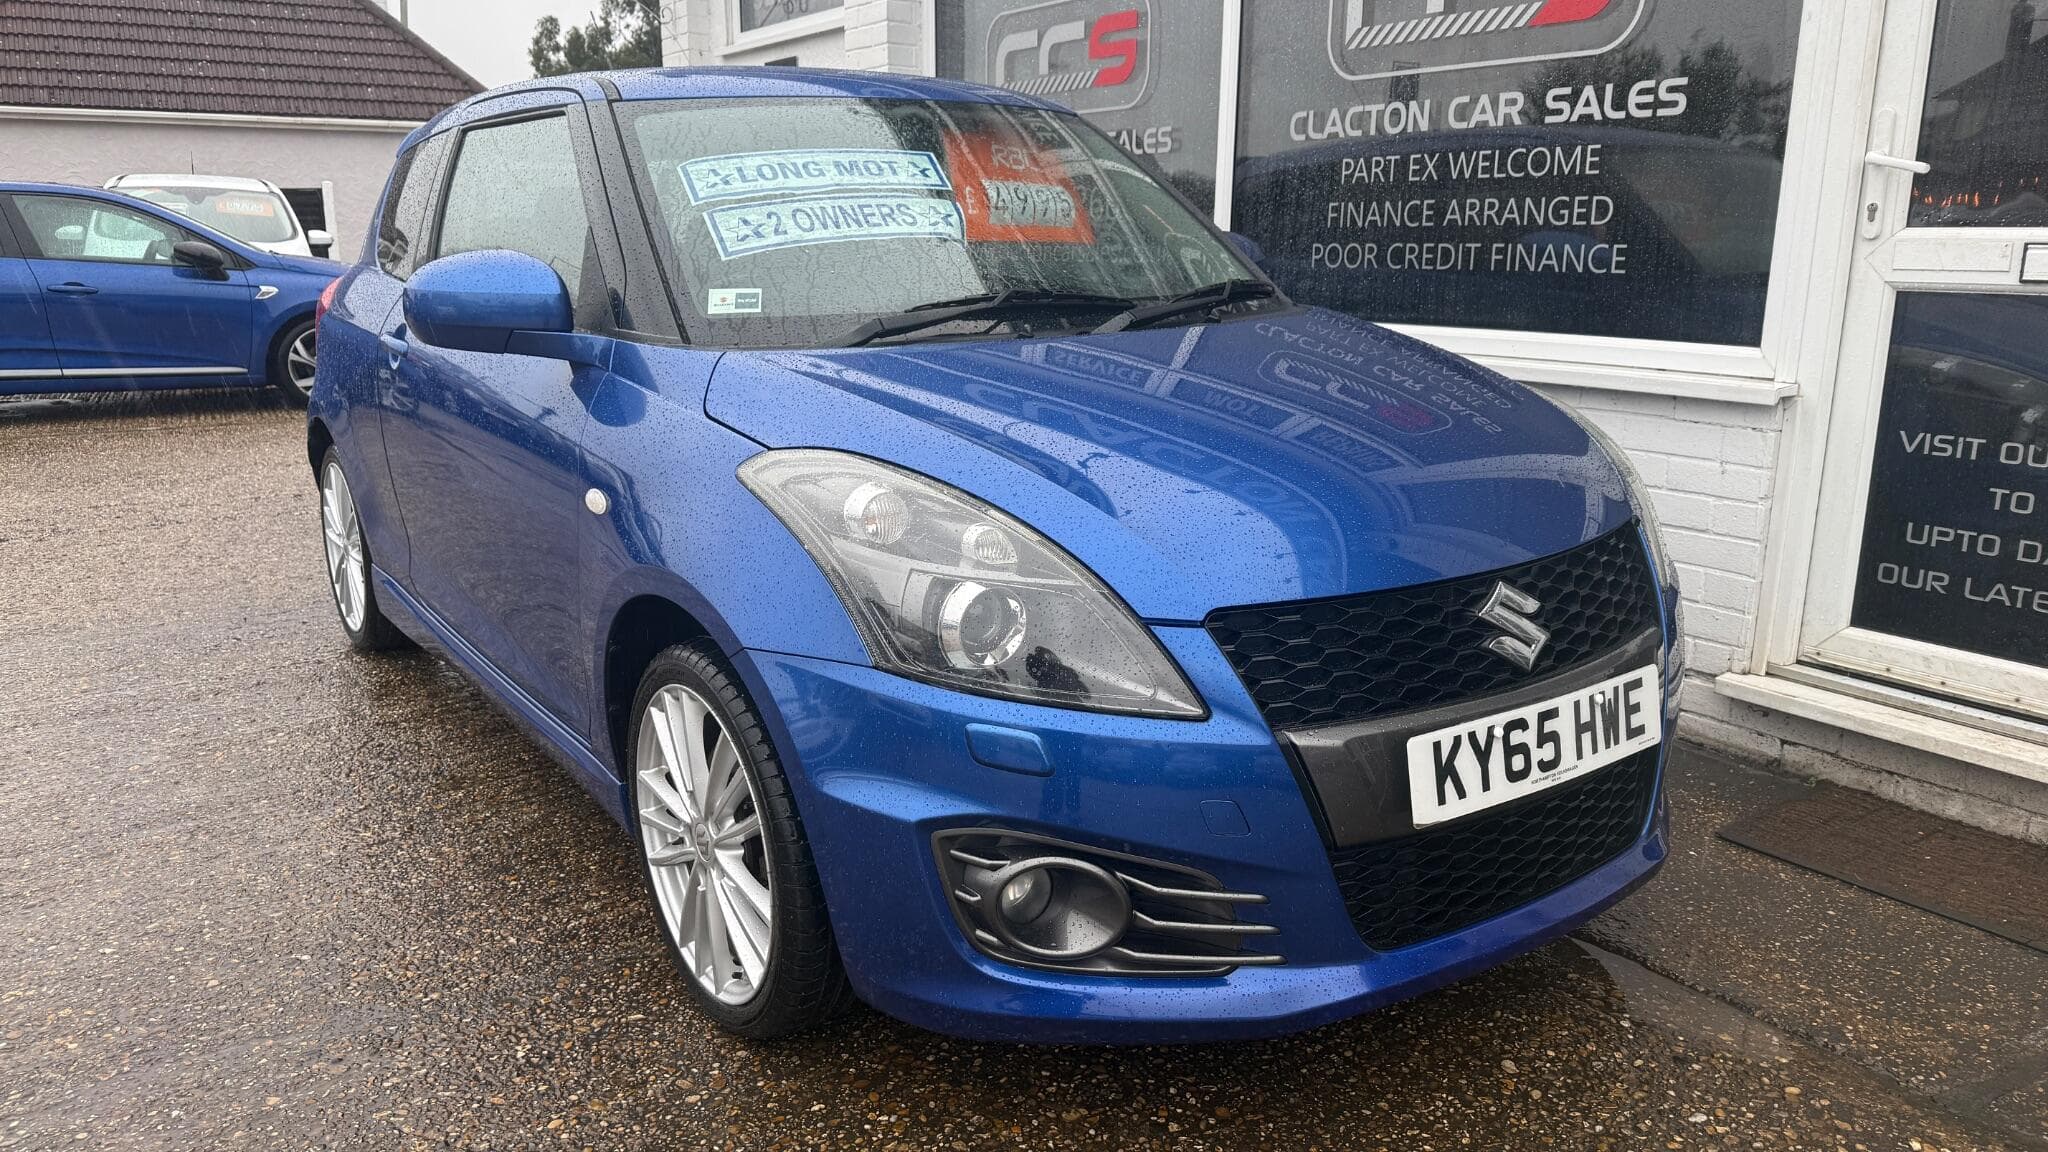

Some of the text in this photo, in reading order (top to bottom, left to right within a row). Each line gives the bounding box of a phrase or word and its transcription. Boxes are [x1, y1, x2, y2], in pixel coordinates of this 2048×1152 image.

[1289, 77, 1689, 142] CLACTON CAR SALES
[736, 160, 900, 184] LONG MOT
[1341, 144, 1602, 185] PART EX WELCOME
[766, 203, 920, 236] 2 OWNERS
[1327, 196, 1614, 229] FINANCE ARRANGED
[1311, 242, 1628, 275] POOR CREDIT FINANCE
[1900, 430, 1987, 461] VISIT
[1989, 488, 2035, 514] TO
[1905, 522, 2048, 566] UPTO D
[1877, 562, 1950, 595] OUR
[1432, 677, 1646, 806] KY65 HWE
